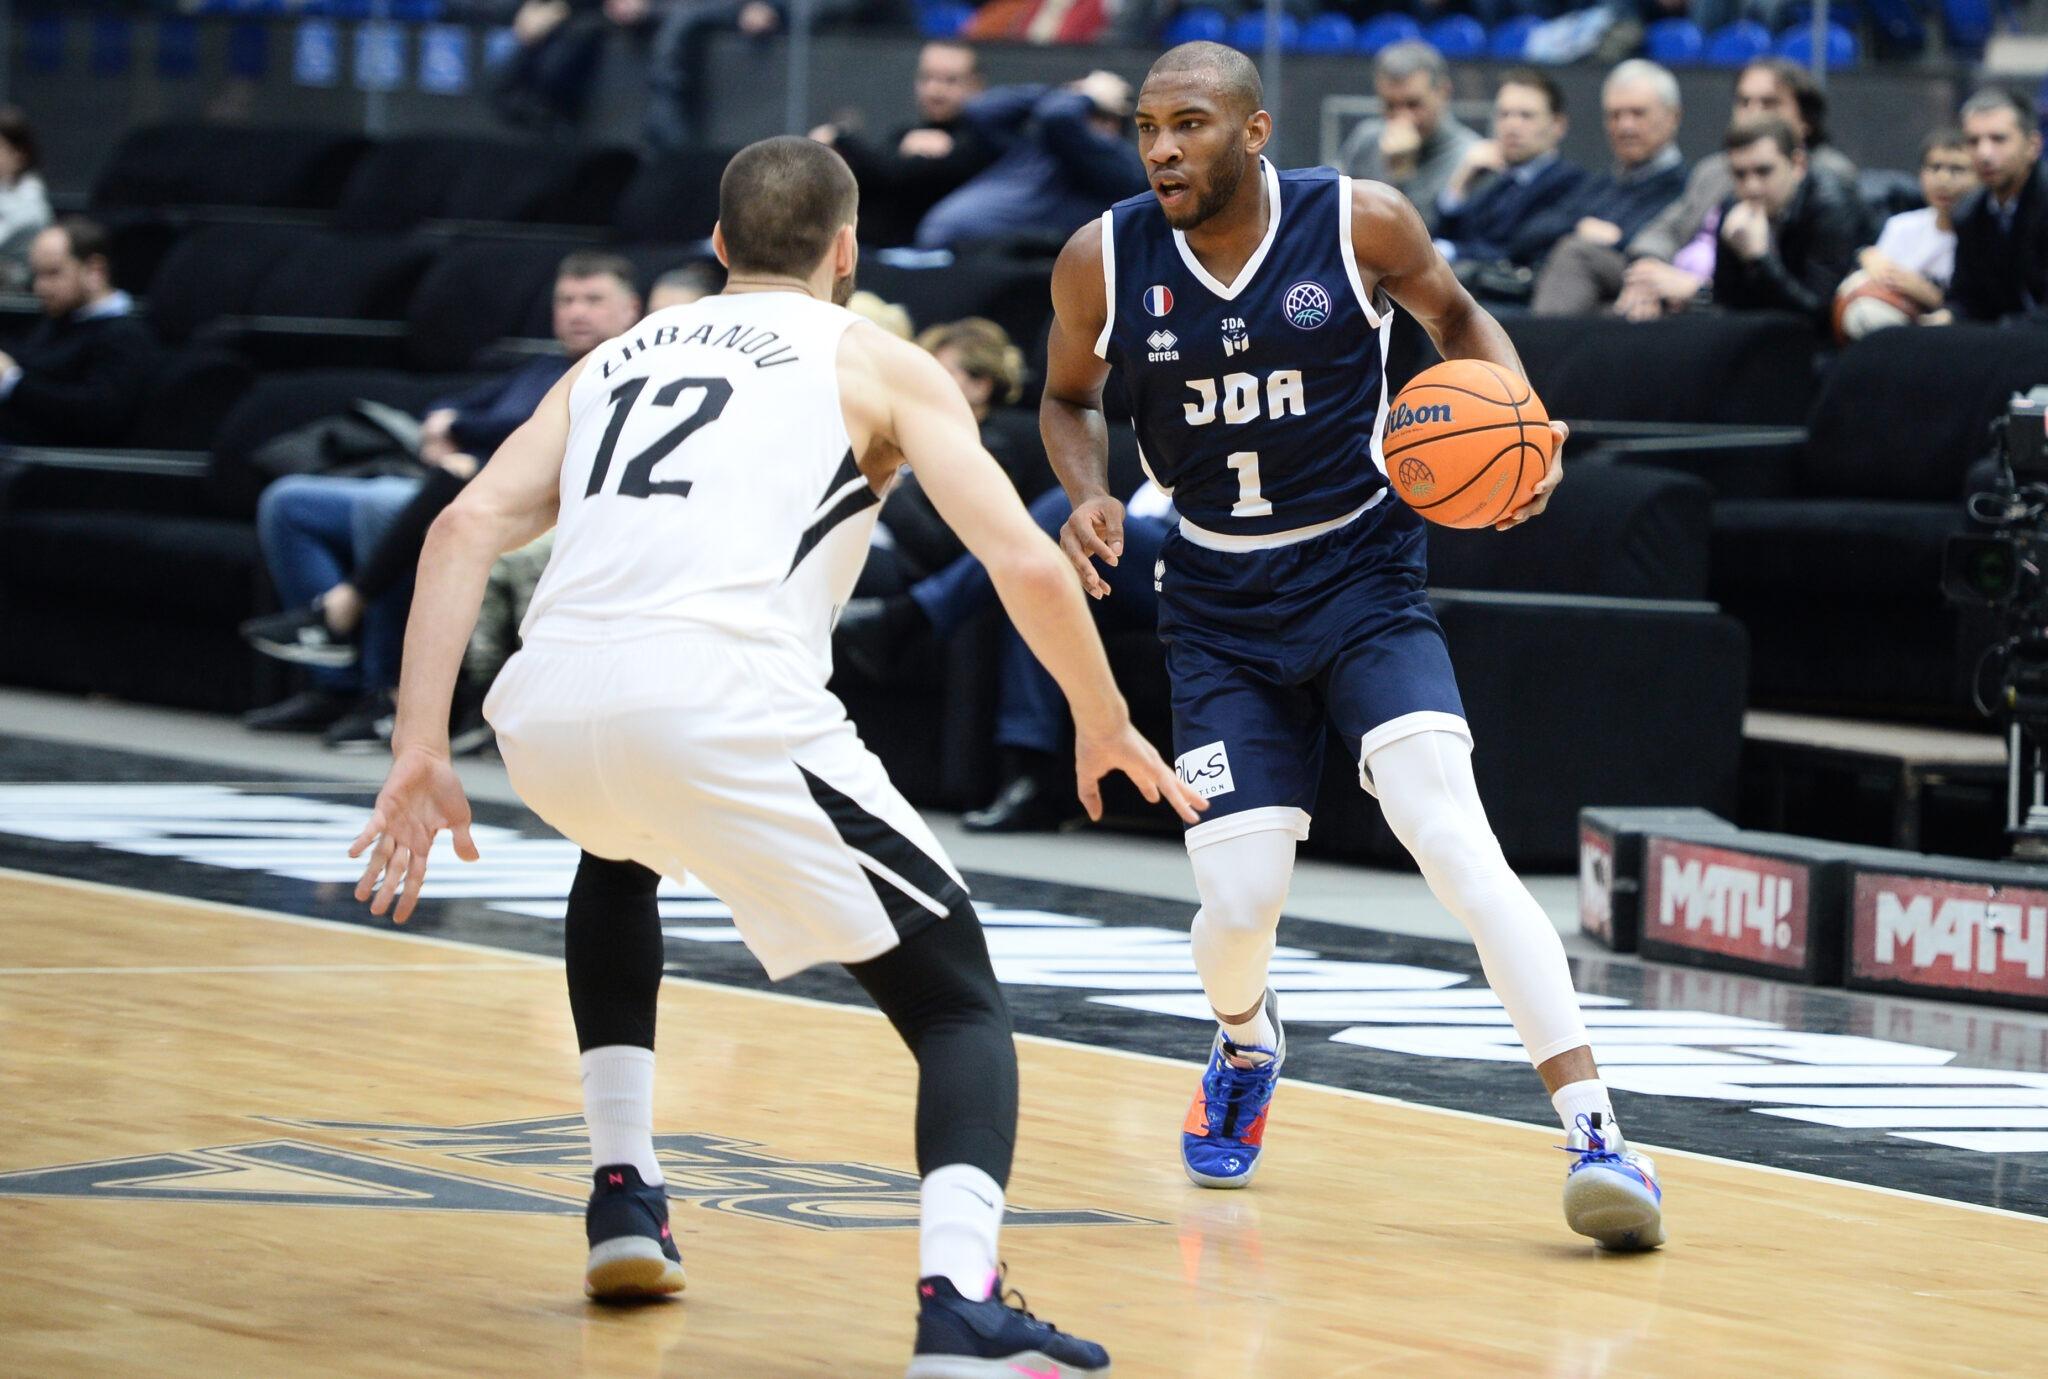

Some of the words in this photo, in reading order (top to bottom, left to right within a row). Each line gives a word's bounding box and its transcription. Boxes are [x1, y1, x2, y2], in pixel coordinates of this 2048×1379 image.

[1221, 318, 1246, 331] JDA
[1182, 369, 1307, 426] JDA
[584, 376, 734, 499] 12
[1226, 451, 1273, 518] 1
